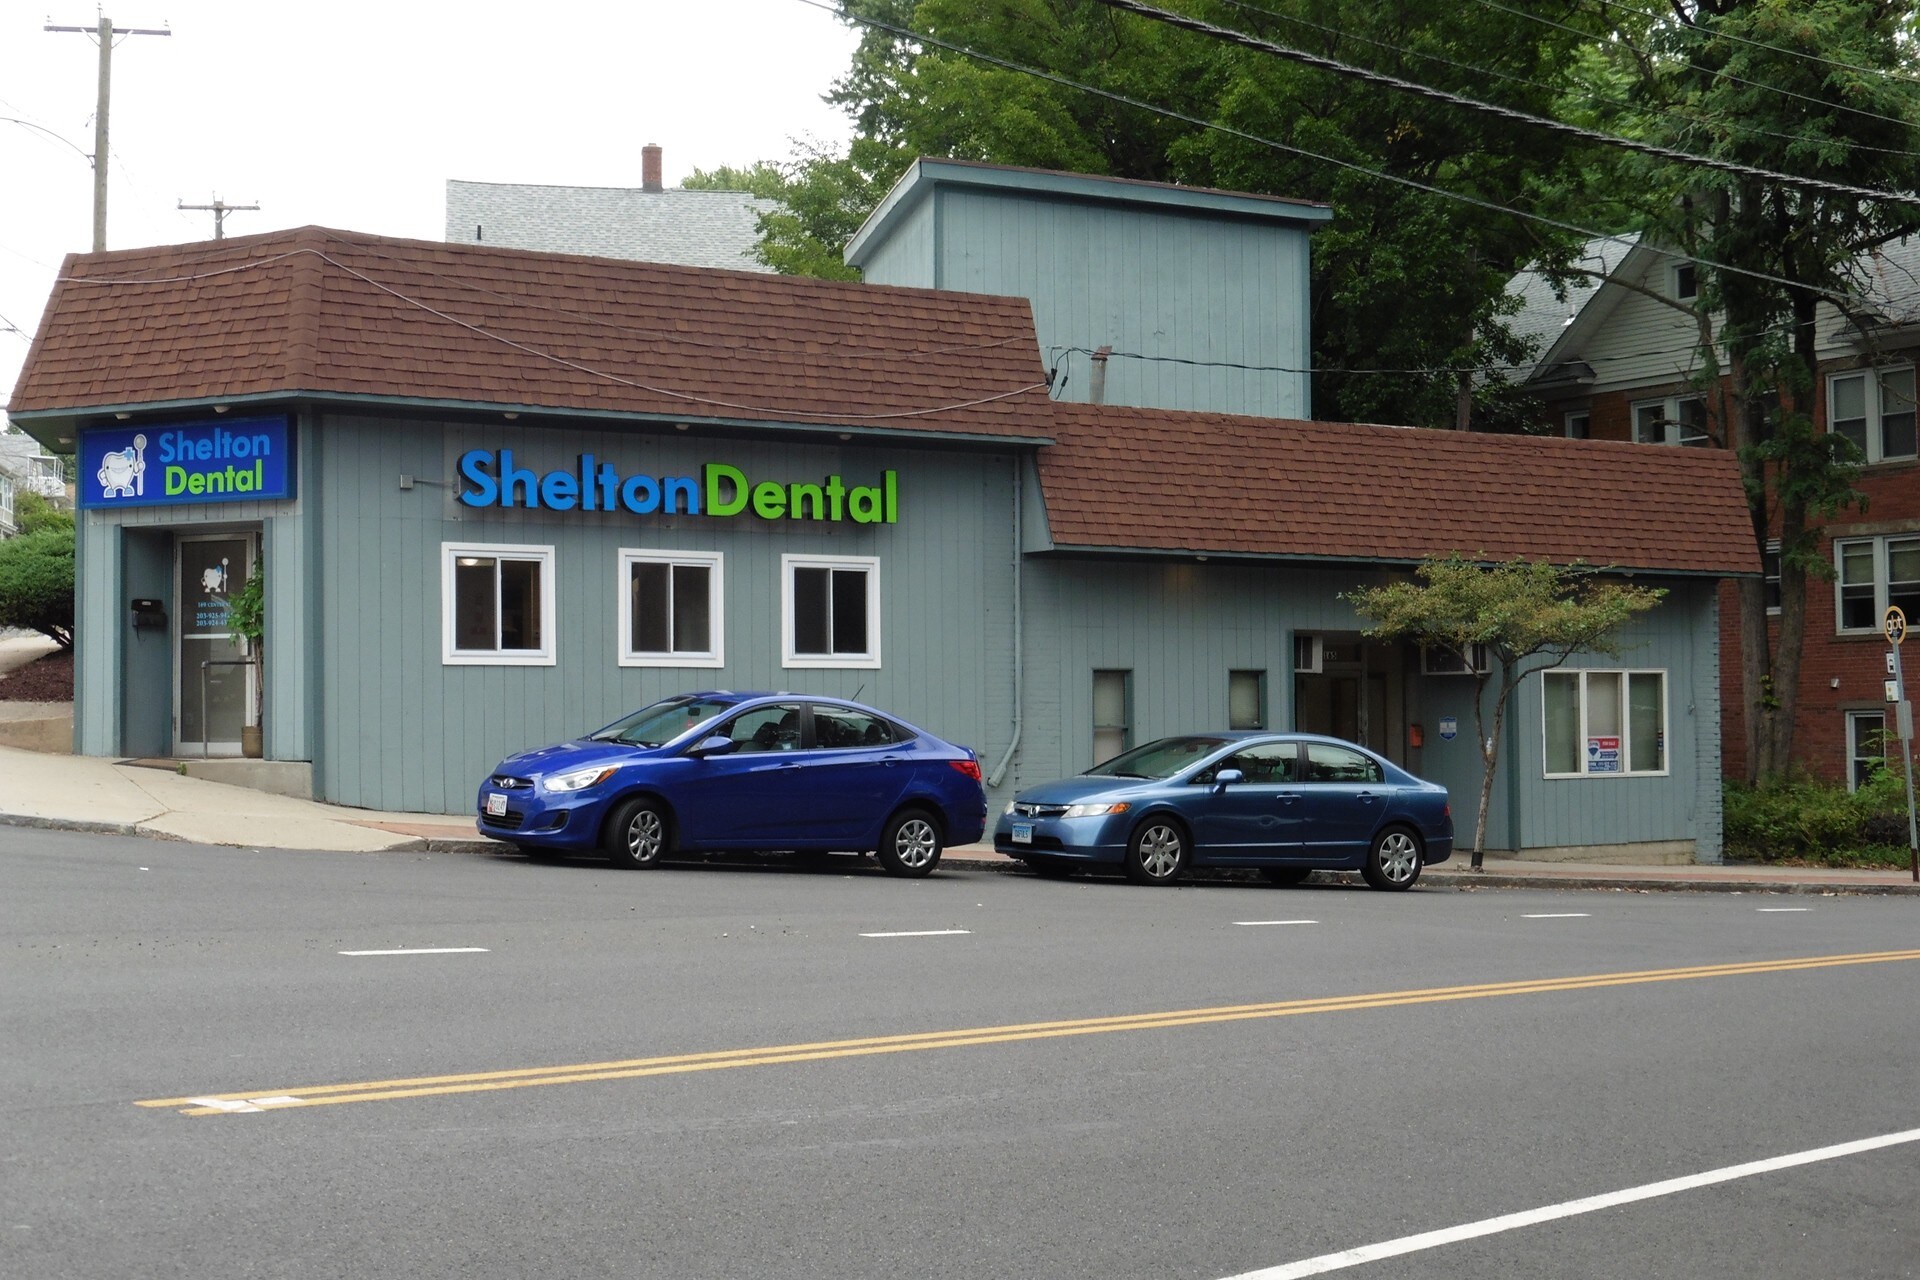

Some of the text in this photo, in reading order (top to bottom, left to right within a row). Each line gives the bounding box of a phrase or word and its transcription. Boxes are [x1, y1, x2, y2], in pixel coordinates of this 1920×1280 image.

[158, 427, 270, 463] Shelton
[165, 458, 263, 496] Dental
[1886, 614, 1903, 635] gbt
